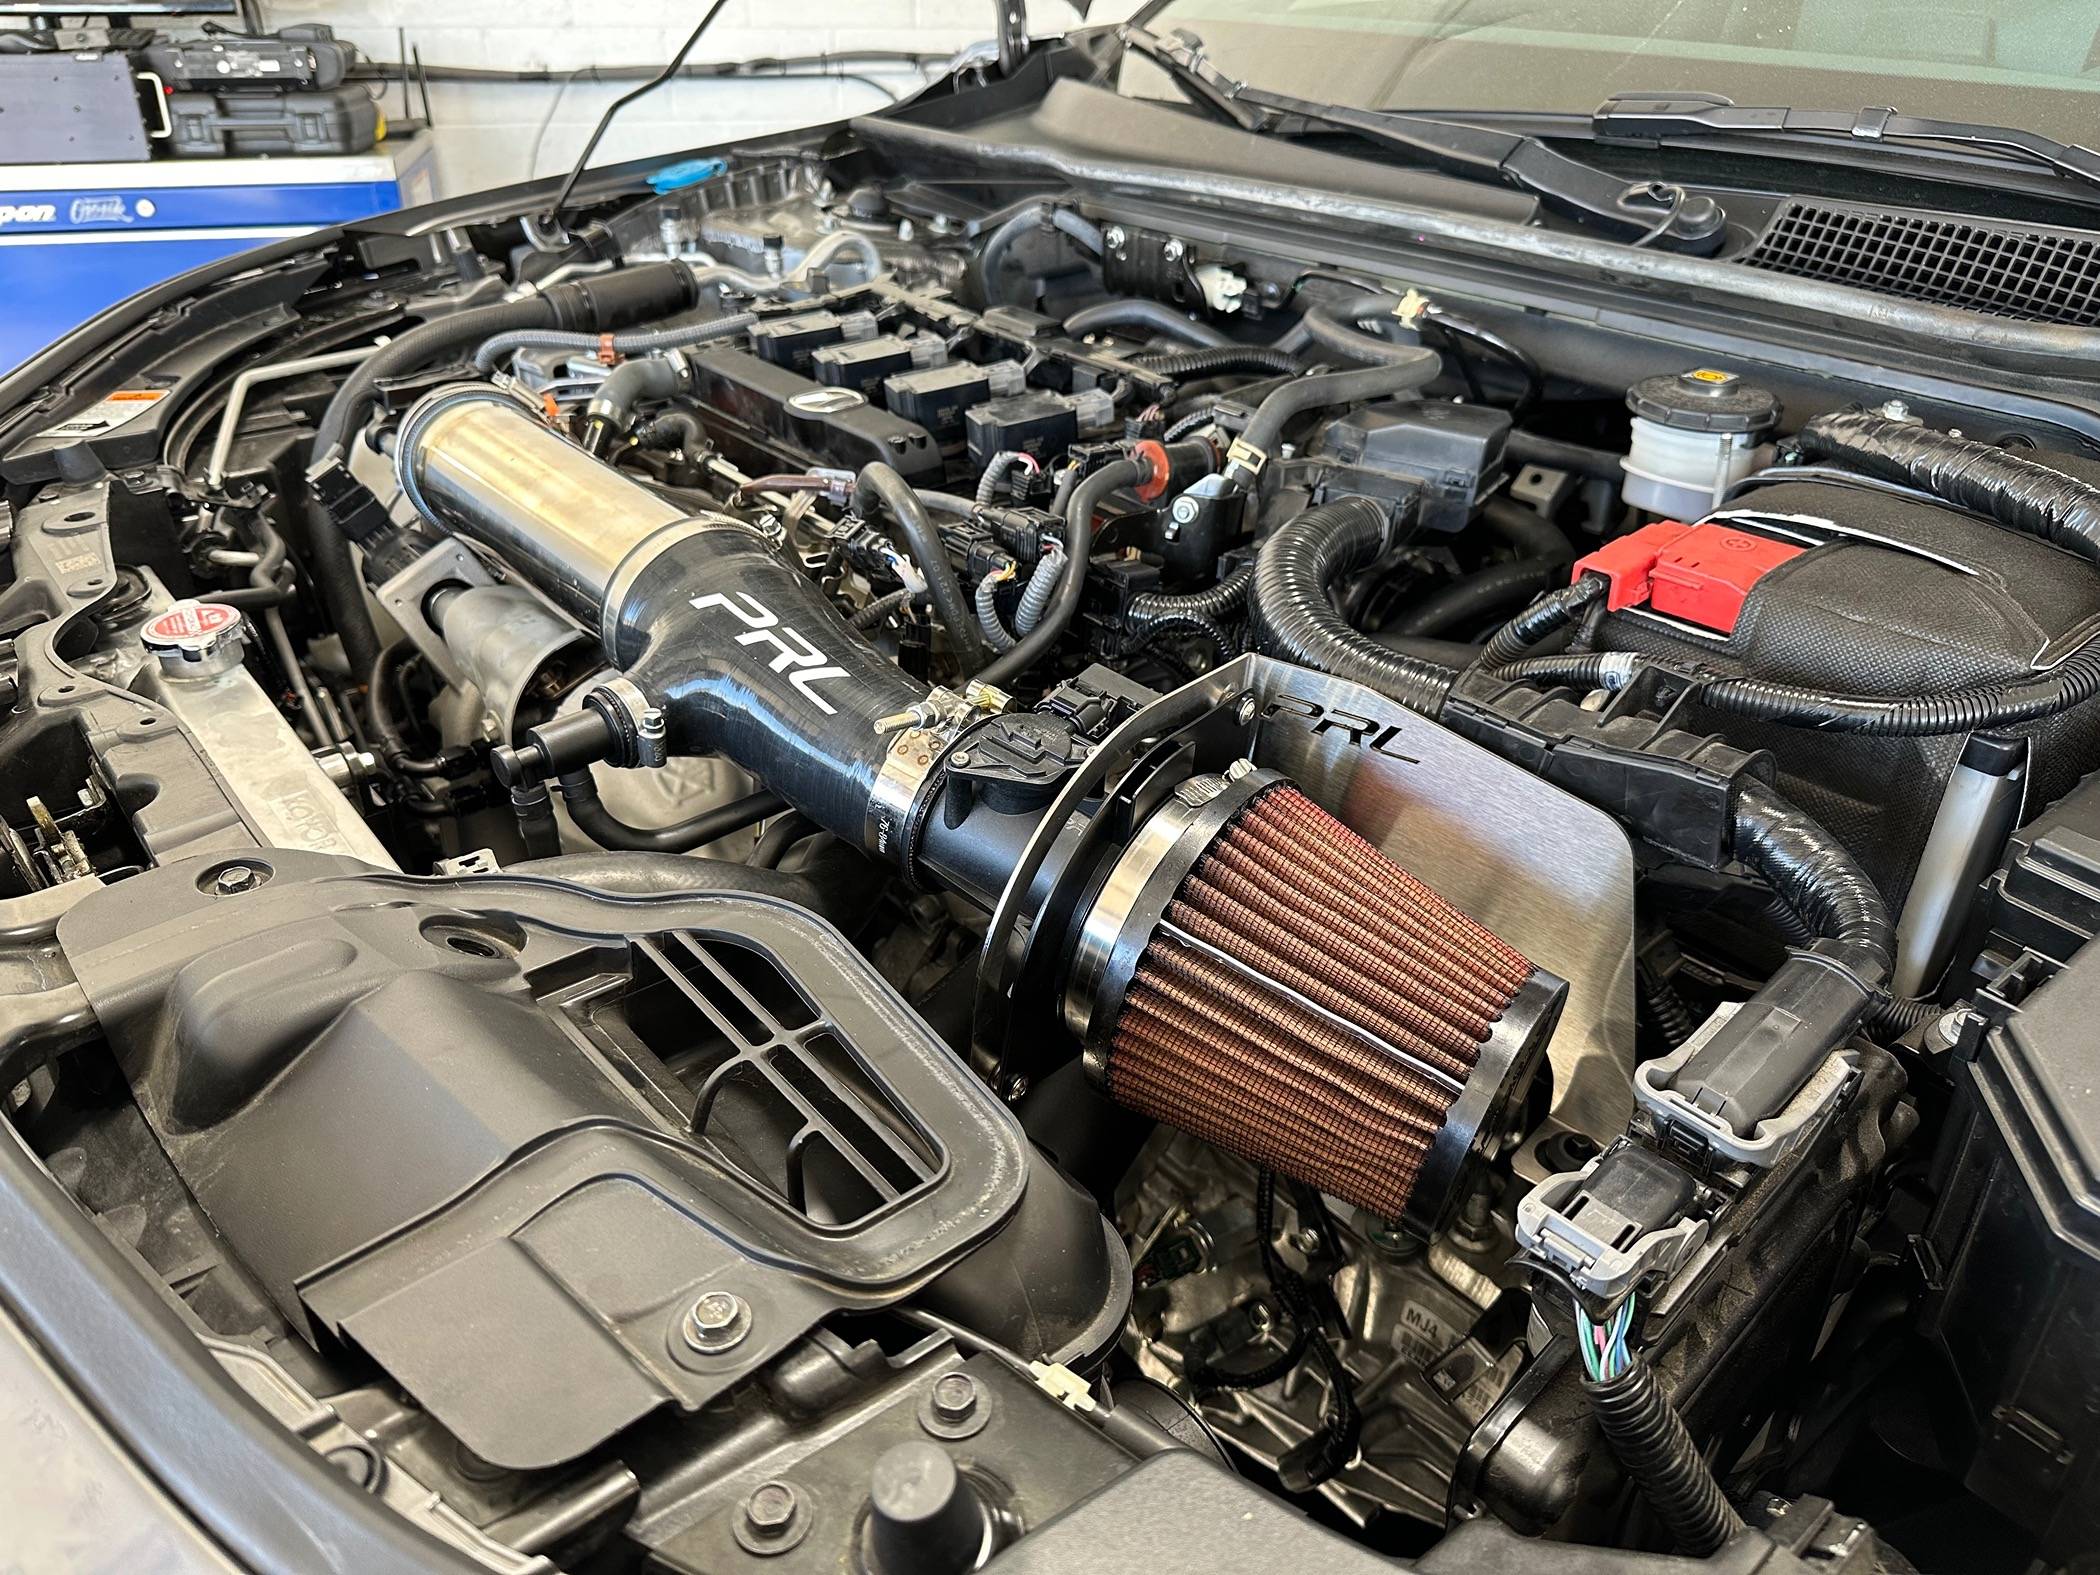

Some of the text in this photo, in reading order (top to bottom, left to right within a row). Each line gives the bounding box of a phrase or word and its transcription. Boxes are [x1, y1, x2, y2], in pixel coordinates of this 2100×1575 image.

[688, 591, 852, 716] PRL
[1260, 694, 1421, 765] PRL
[1406, 1308, 1438, 1339] MJ4
